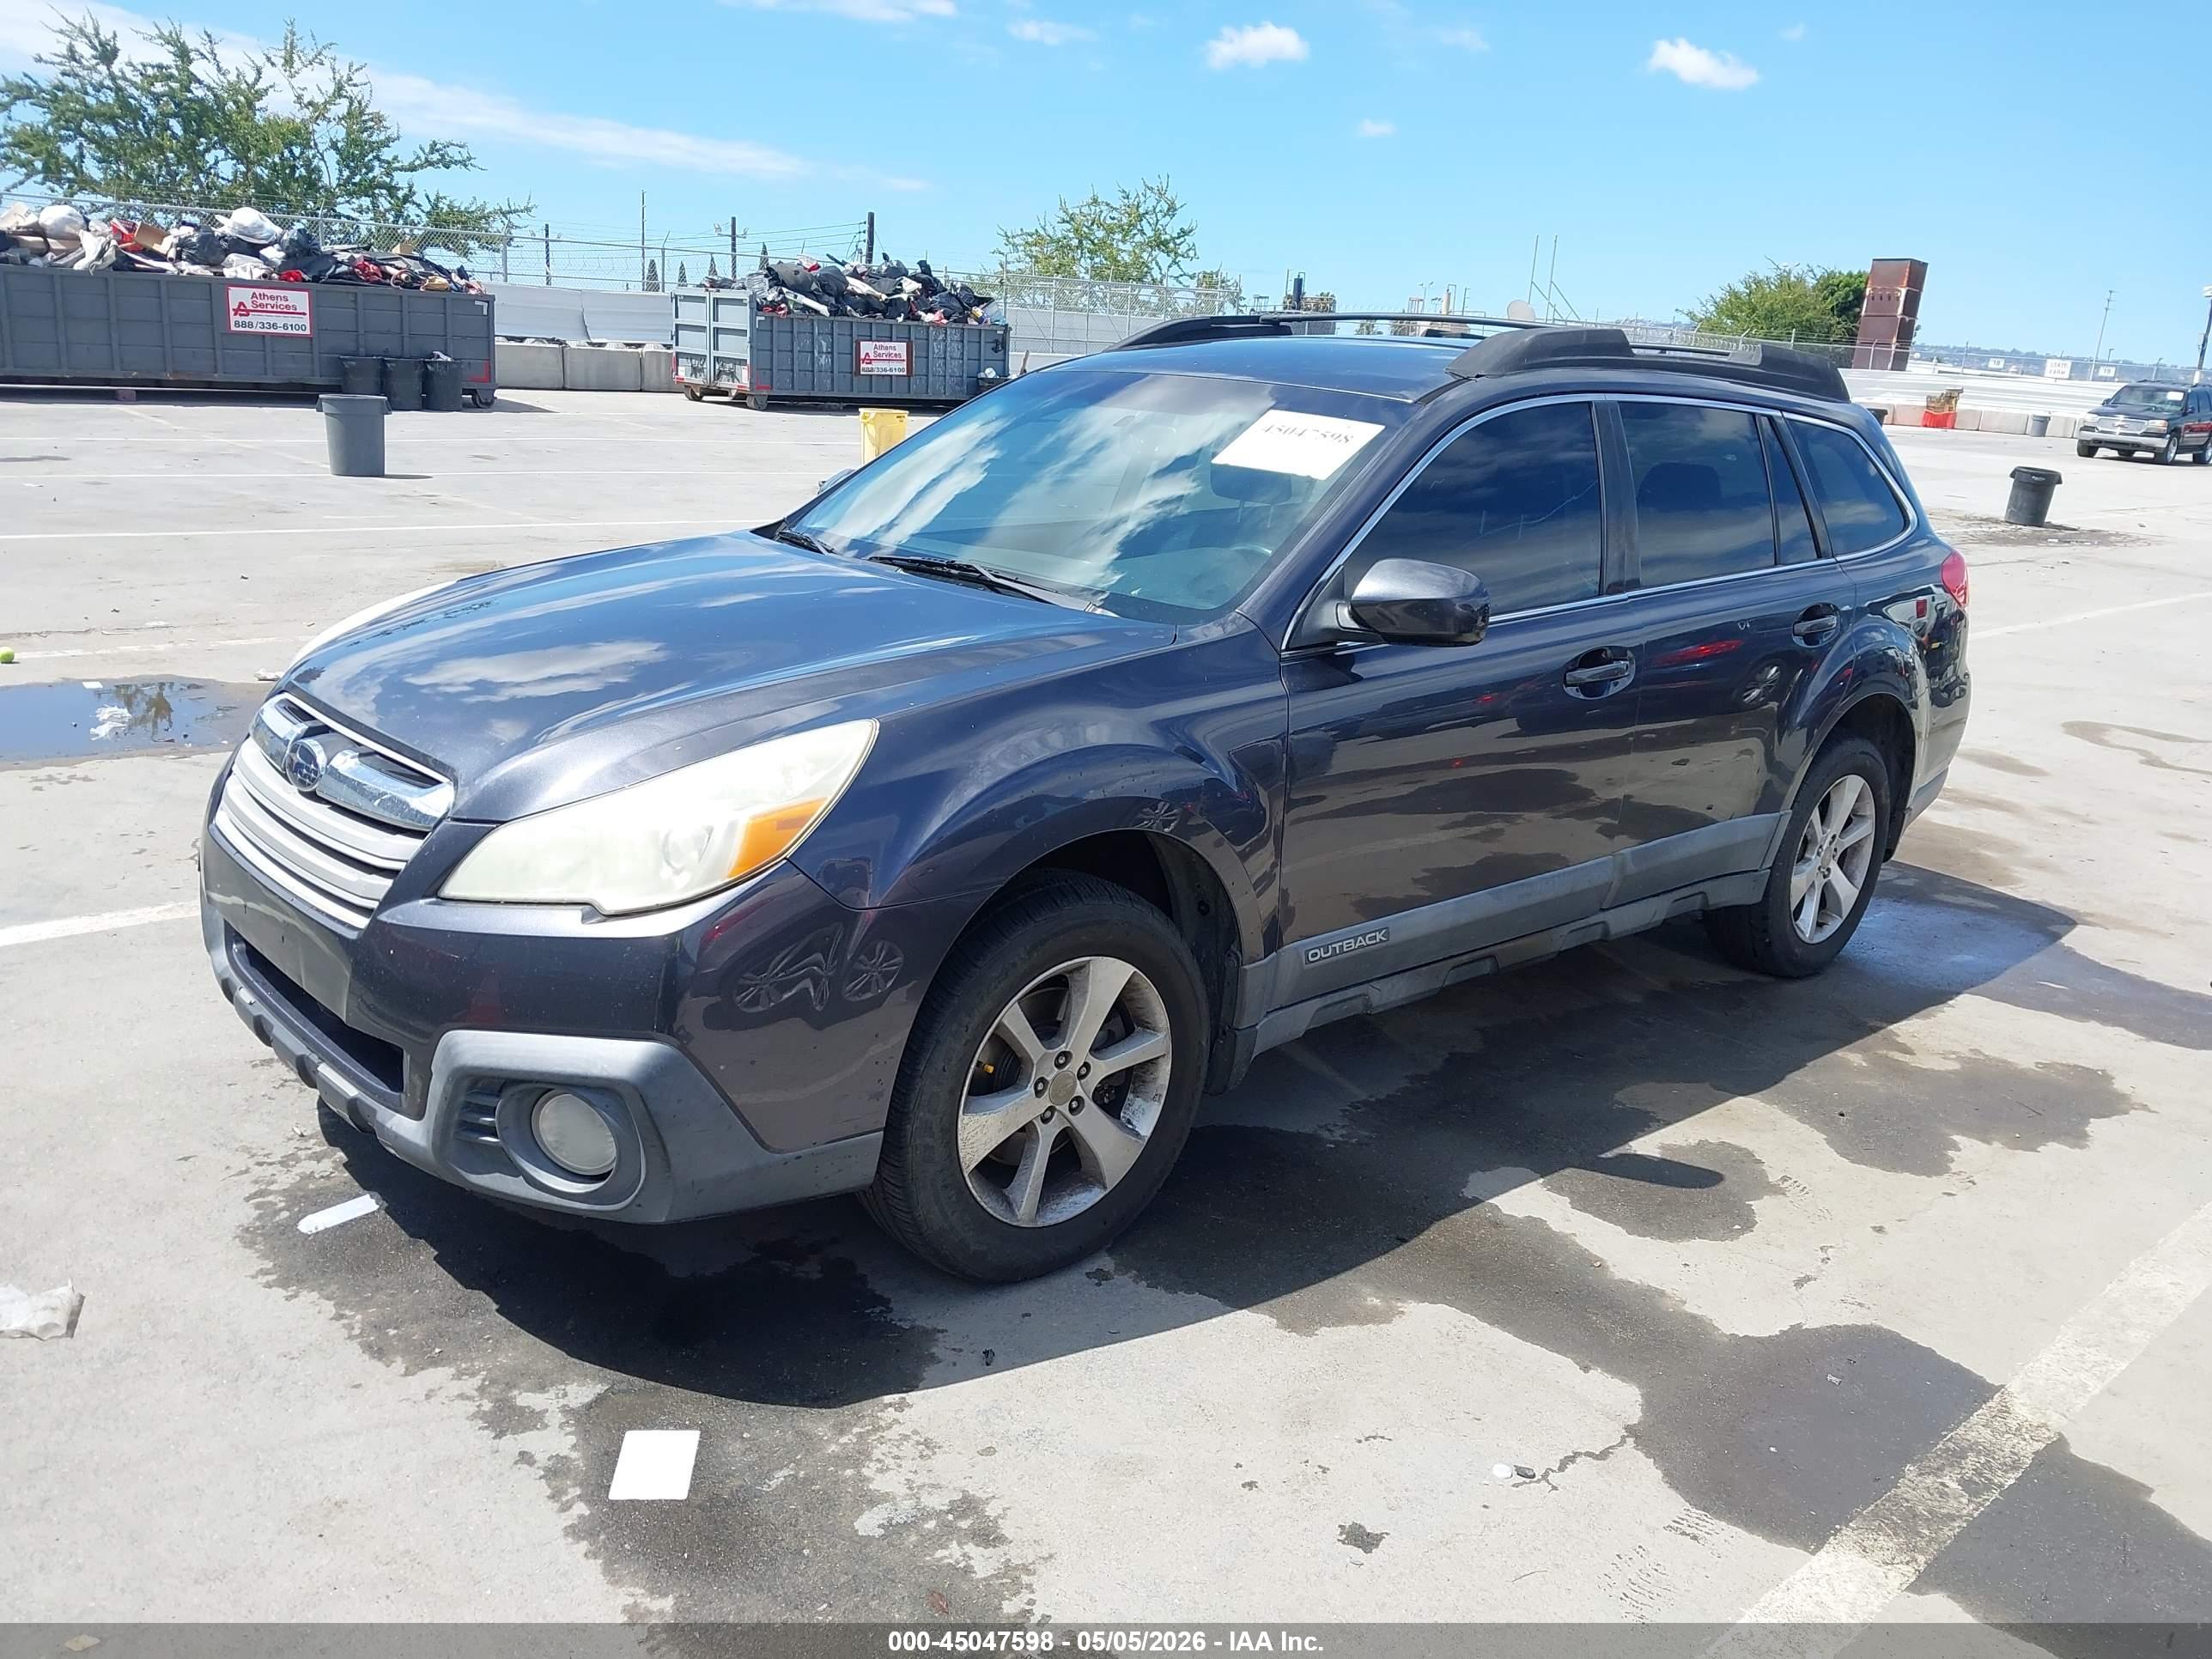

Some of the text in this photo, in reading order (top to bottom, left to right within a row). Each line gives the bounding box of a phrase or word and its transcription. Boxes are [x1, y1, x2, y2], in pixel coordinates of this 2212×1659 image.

[251, 292, 289, 302] Athens
[251, 301, 298, 311] Services
[234, 320, 307, 331] 888/336-6100
[1308, 929, 1388, 962] OUTBACK
